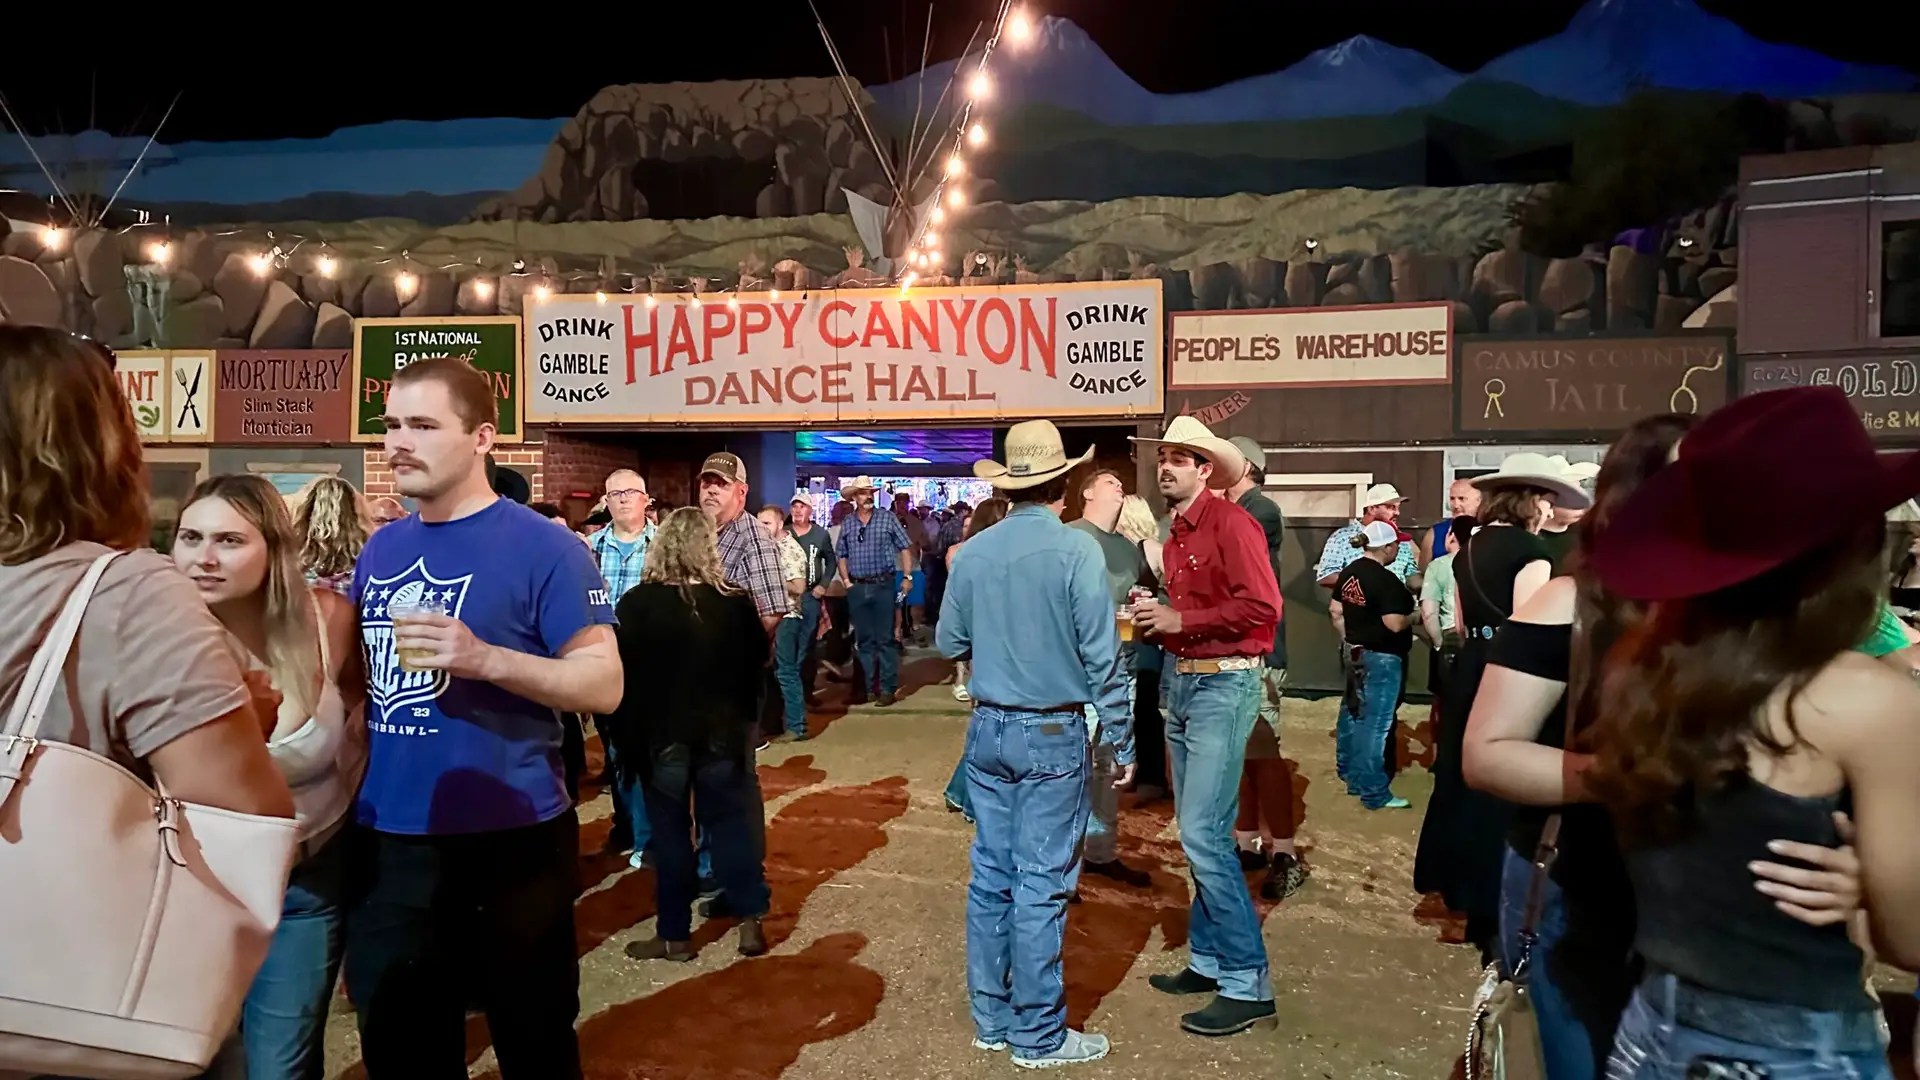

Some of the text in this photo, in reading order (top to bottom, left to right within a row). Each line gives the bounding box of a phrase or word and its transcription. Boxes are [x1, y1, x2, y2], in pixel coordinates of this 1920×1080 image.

[537, 316, 617, 342] DRINK
[1064, 303, 1150, 331] DRINK
[394, 330, 482, 346] 1ST NATIONAL
[622, 297, 1057, 384] HAPPY CANYON
[1173, 329, 1448, 362] PEOPLE'S WAREHOUSE
[538, 352, 610, 376] GAMBLE
[1066, 340, 1146, 365] GAMBLE
[1474, 346, 1718, 371] CAMUS COUNTY
[219, 352, 350, 392] MORTUARY
[683, 362, 996, 406] DANCE HALL
[1067, 369, 1148, 396] DANCE
[1811, 360, 1920, 399] GOLD
[242, 396, 315, 414] Slim Stack
[541, 381, 610, 404] DANCE
[1544, 378, 1634, 413] JAIL
[242, 418, 314, 438] Mortician
[1887, 411, 1901, 428] &
[1905, 411, 1920, 428] M
